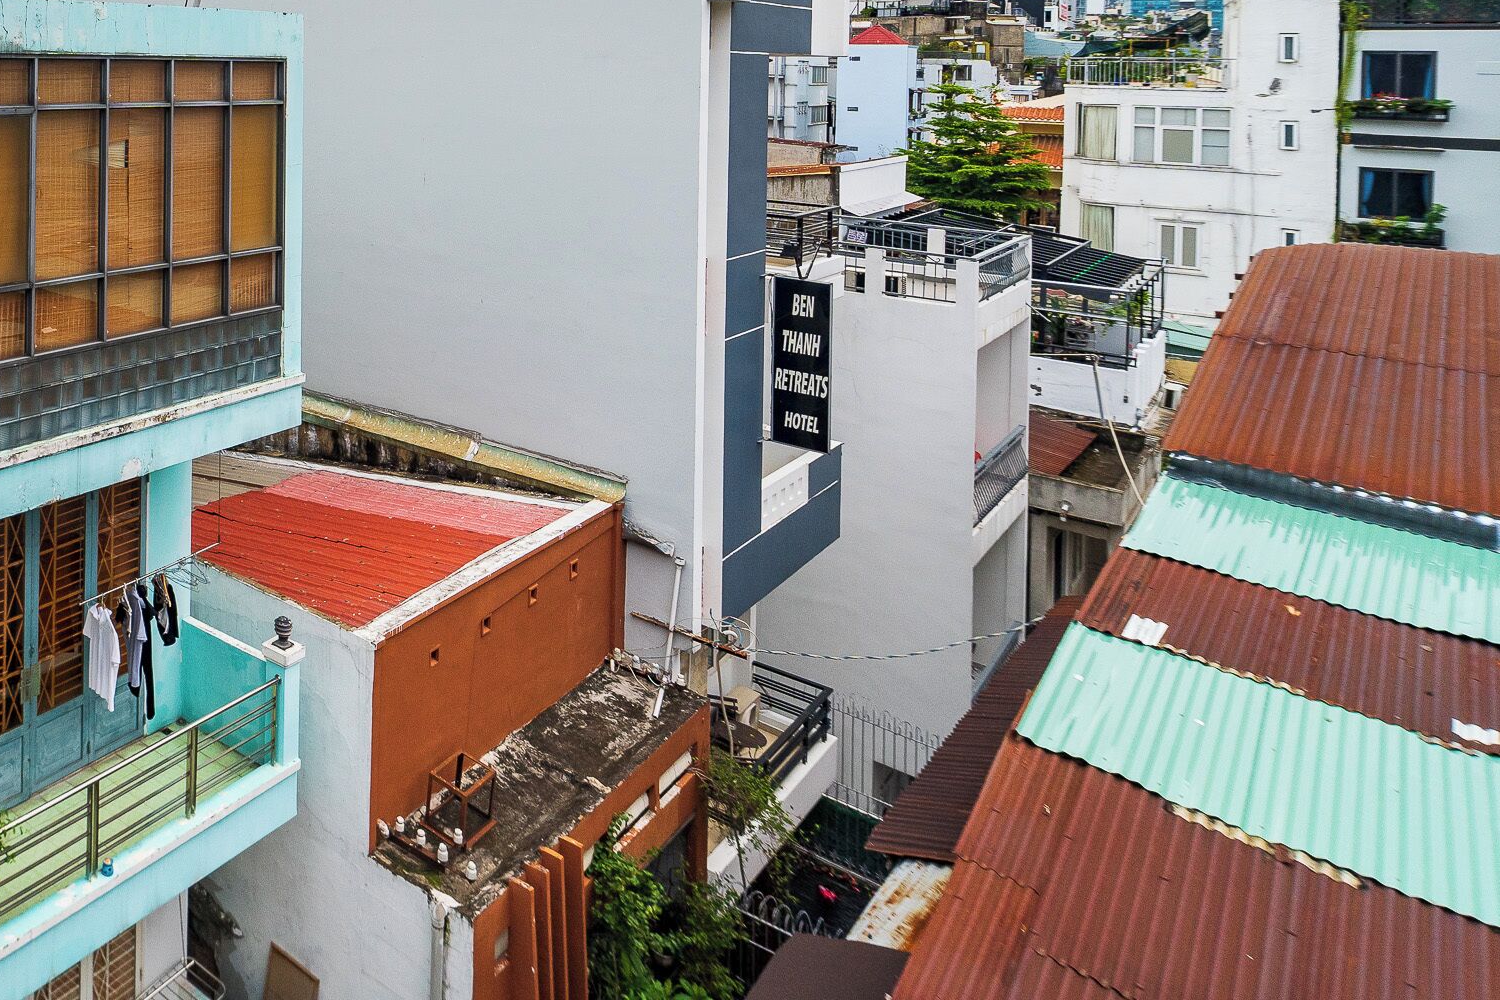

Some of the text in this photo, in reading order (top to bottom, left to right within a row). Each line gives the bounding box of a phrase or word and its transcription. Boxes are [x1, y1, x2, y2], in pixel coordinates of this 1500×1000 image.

[792, 294, 814, 318] BEN
[782, 329, 821, 357] THANH
[775, 368, 828, 398] RETREATS
[784, 411, 819, 434] HOTEL
